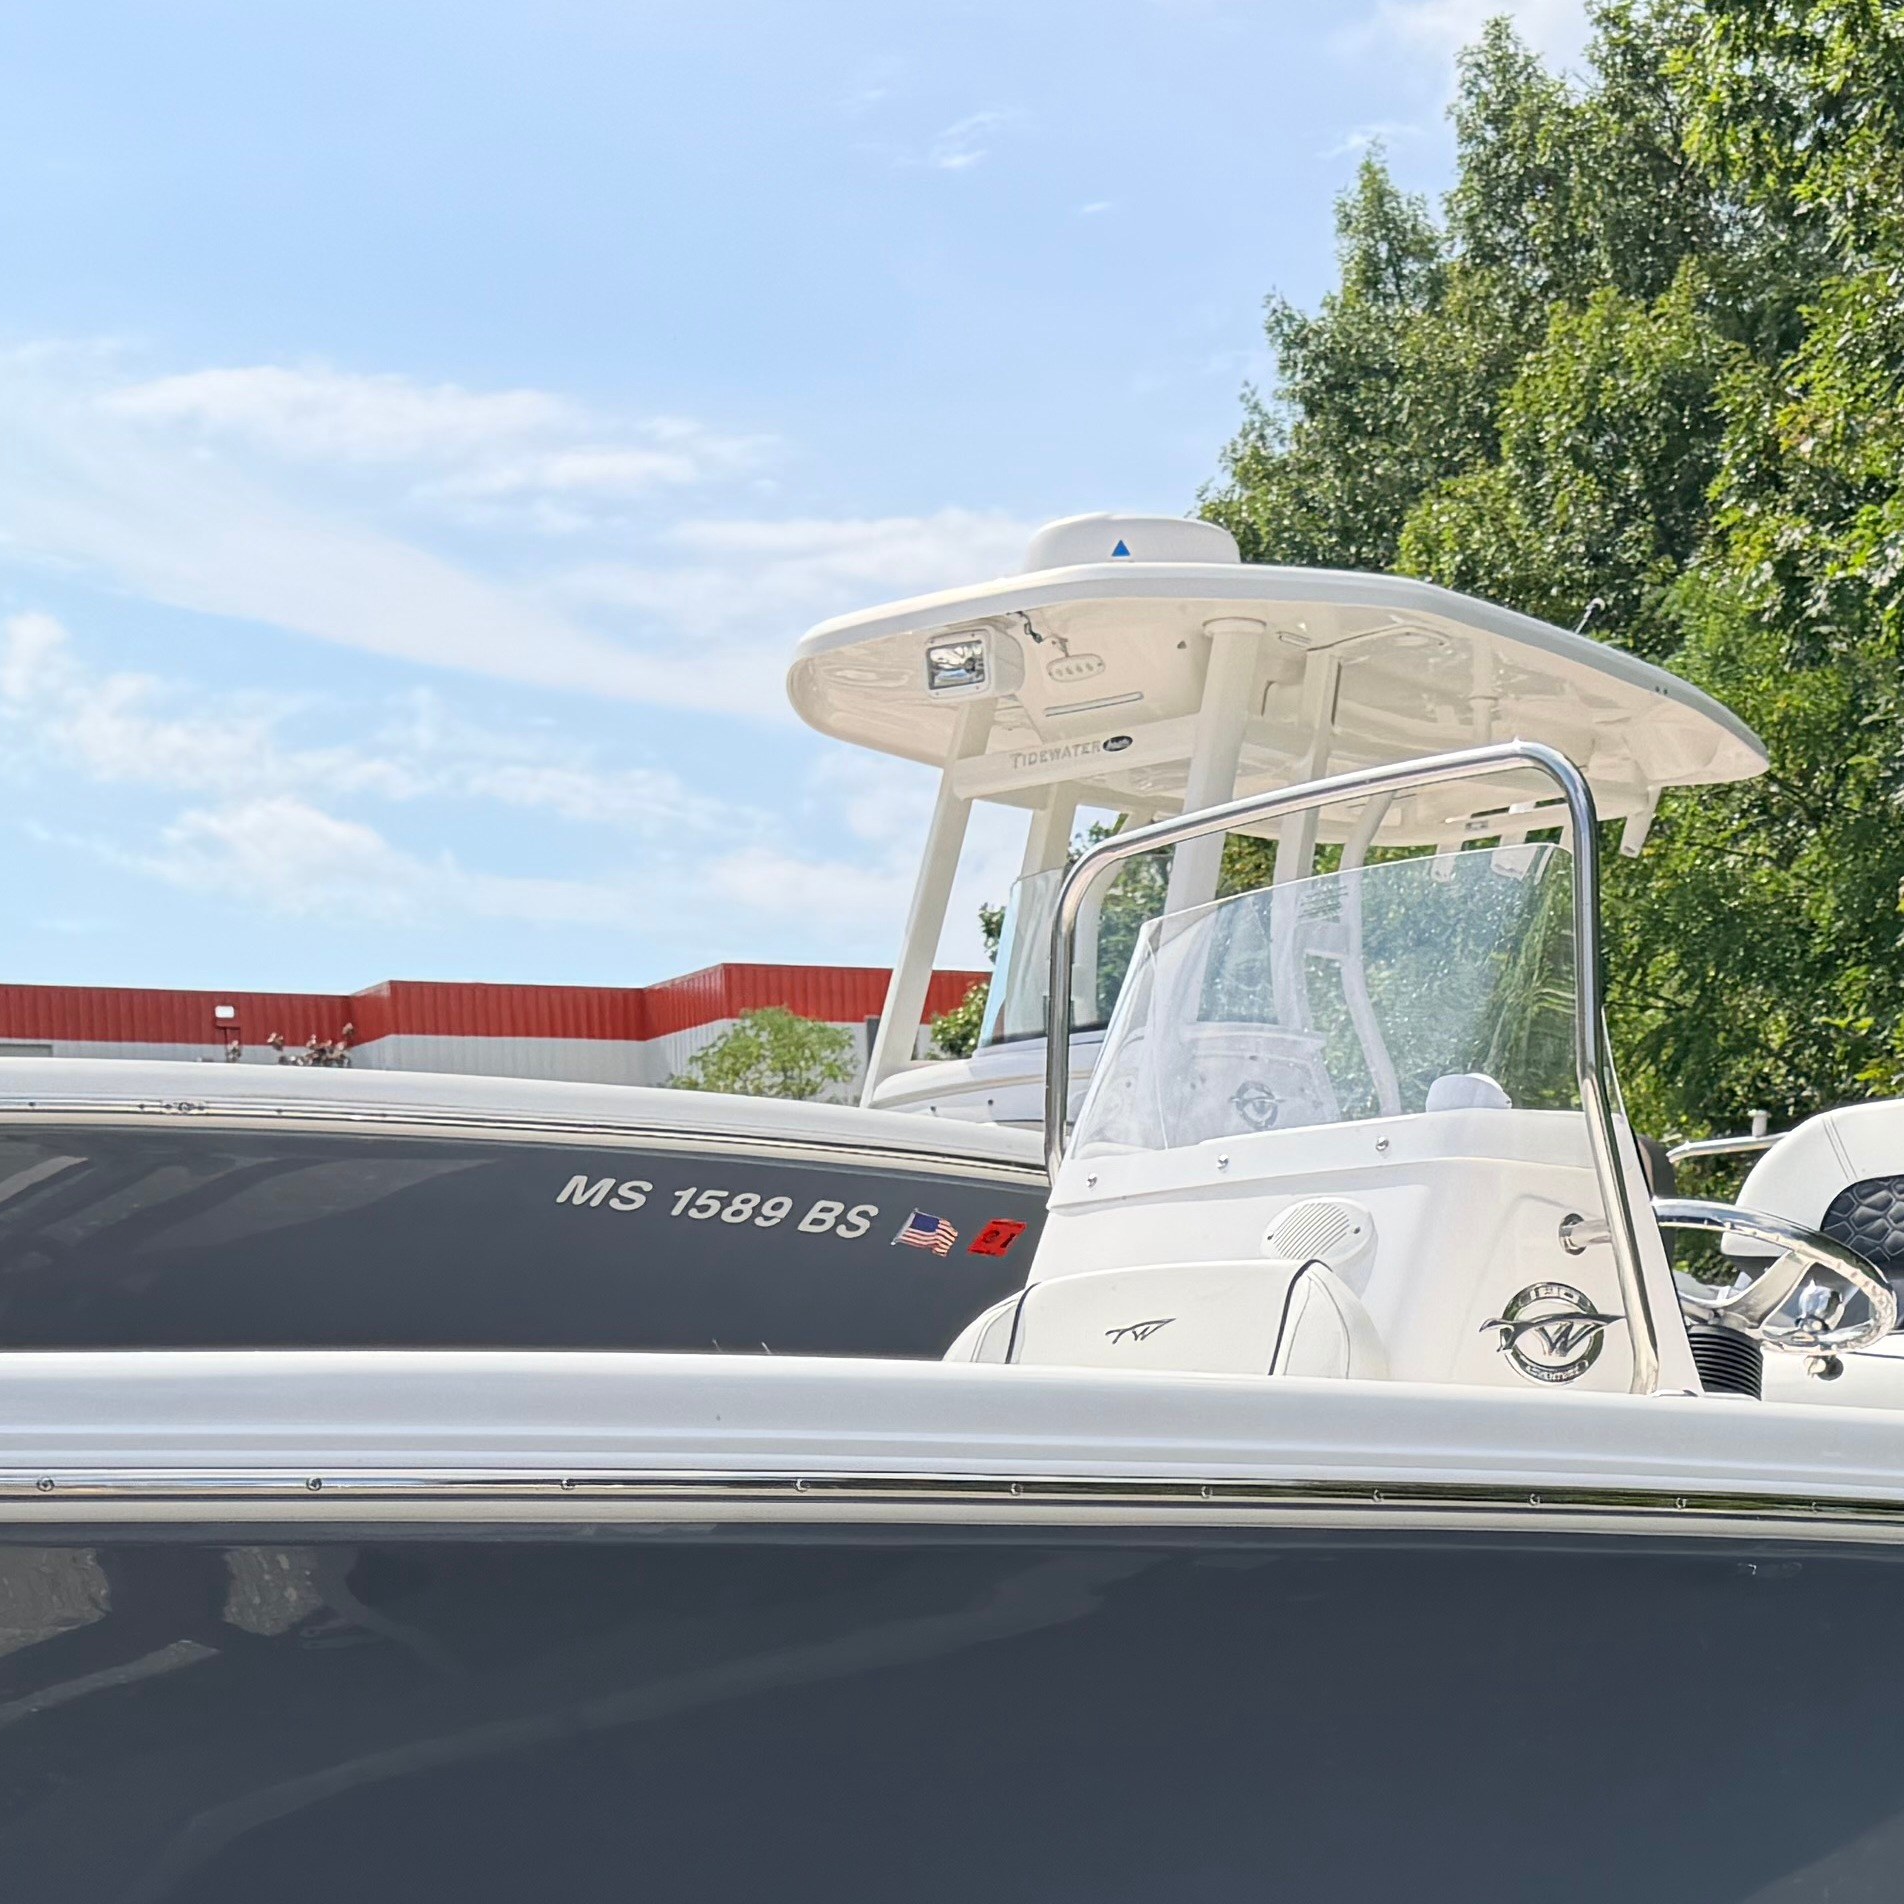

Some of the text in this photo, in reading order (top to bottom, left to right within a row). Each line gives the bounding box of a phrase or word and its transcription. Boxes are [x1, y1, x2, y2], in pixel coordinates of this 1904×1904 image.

[555, 1174, 879, 1239] MS 1589 BS
